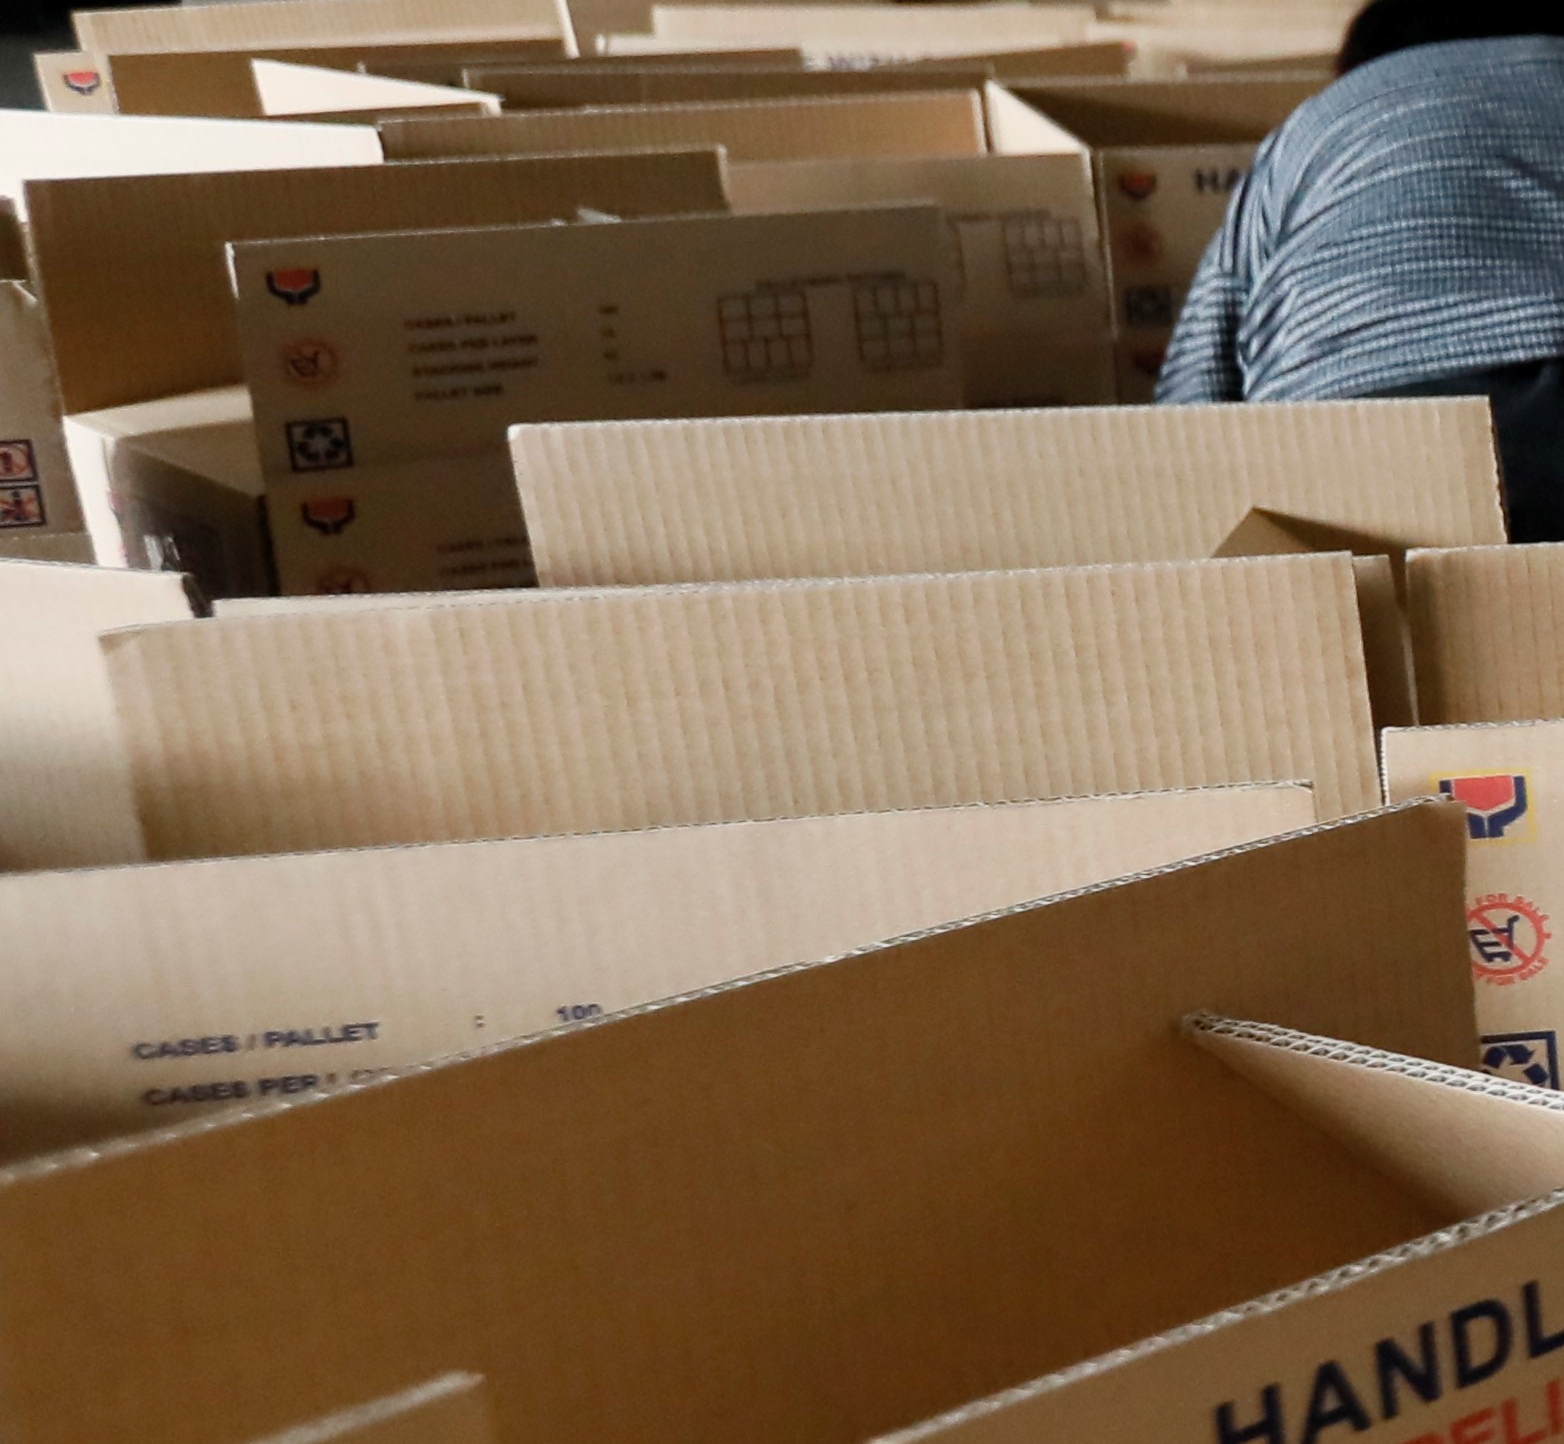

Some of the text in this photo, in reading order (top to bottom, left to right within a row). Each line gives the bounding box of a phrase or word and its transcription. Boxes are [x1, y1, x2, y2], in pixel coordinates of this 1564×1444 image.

[131, 1020, 379, 1061] CASES PALLET
[142, 1073, 319, 1107] CASES PER
